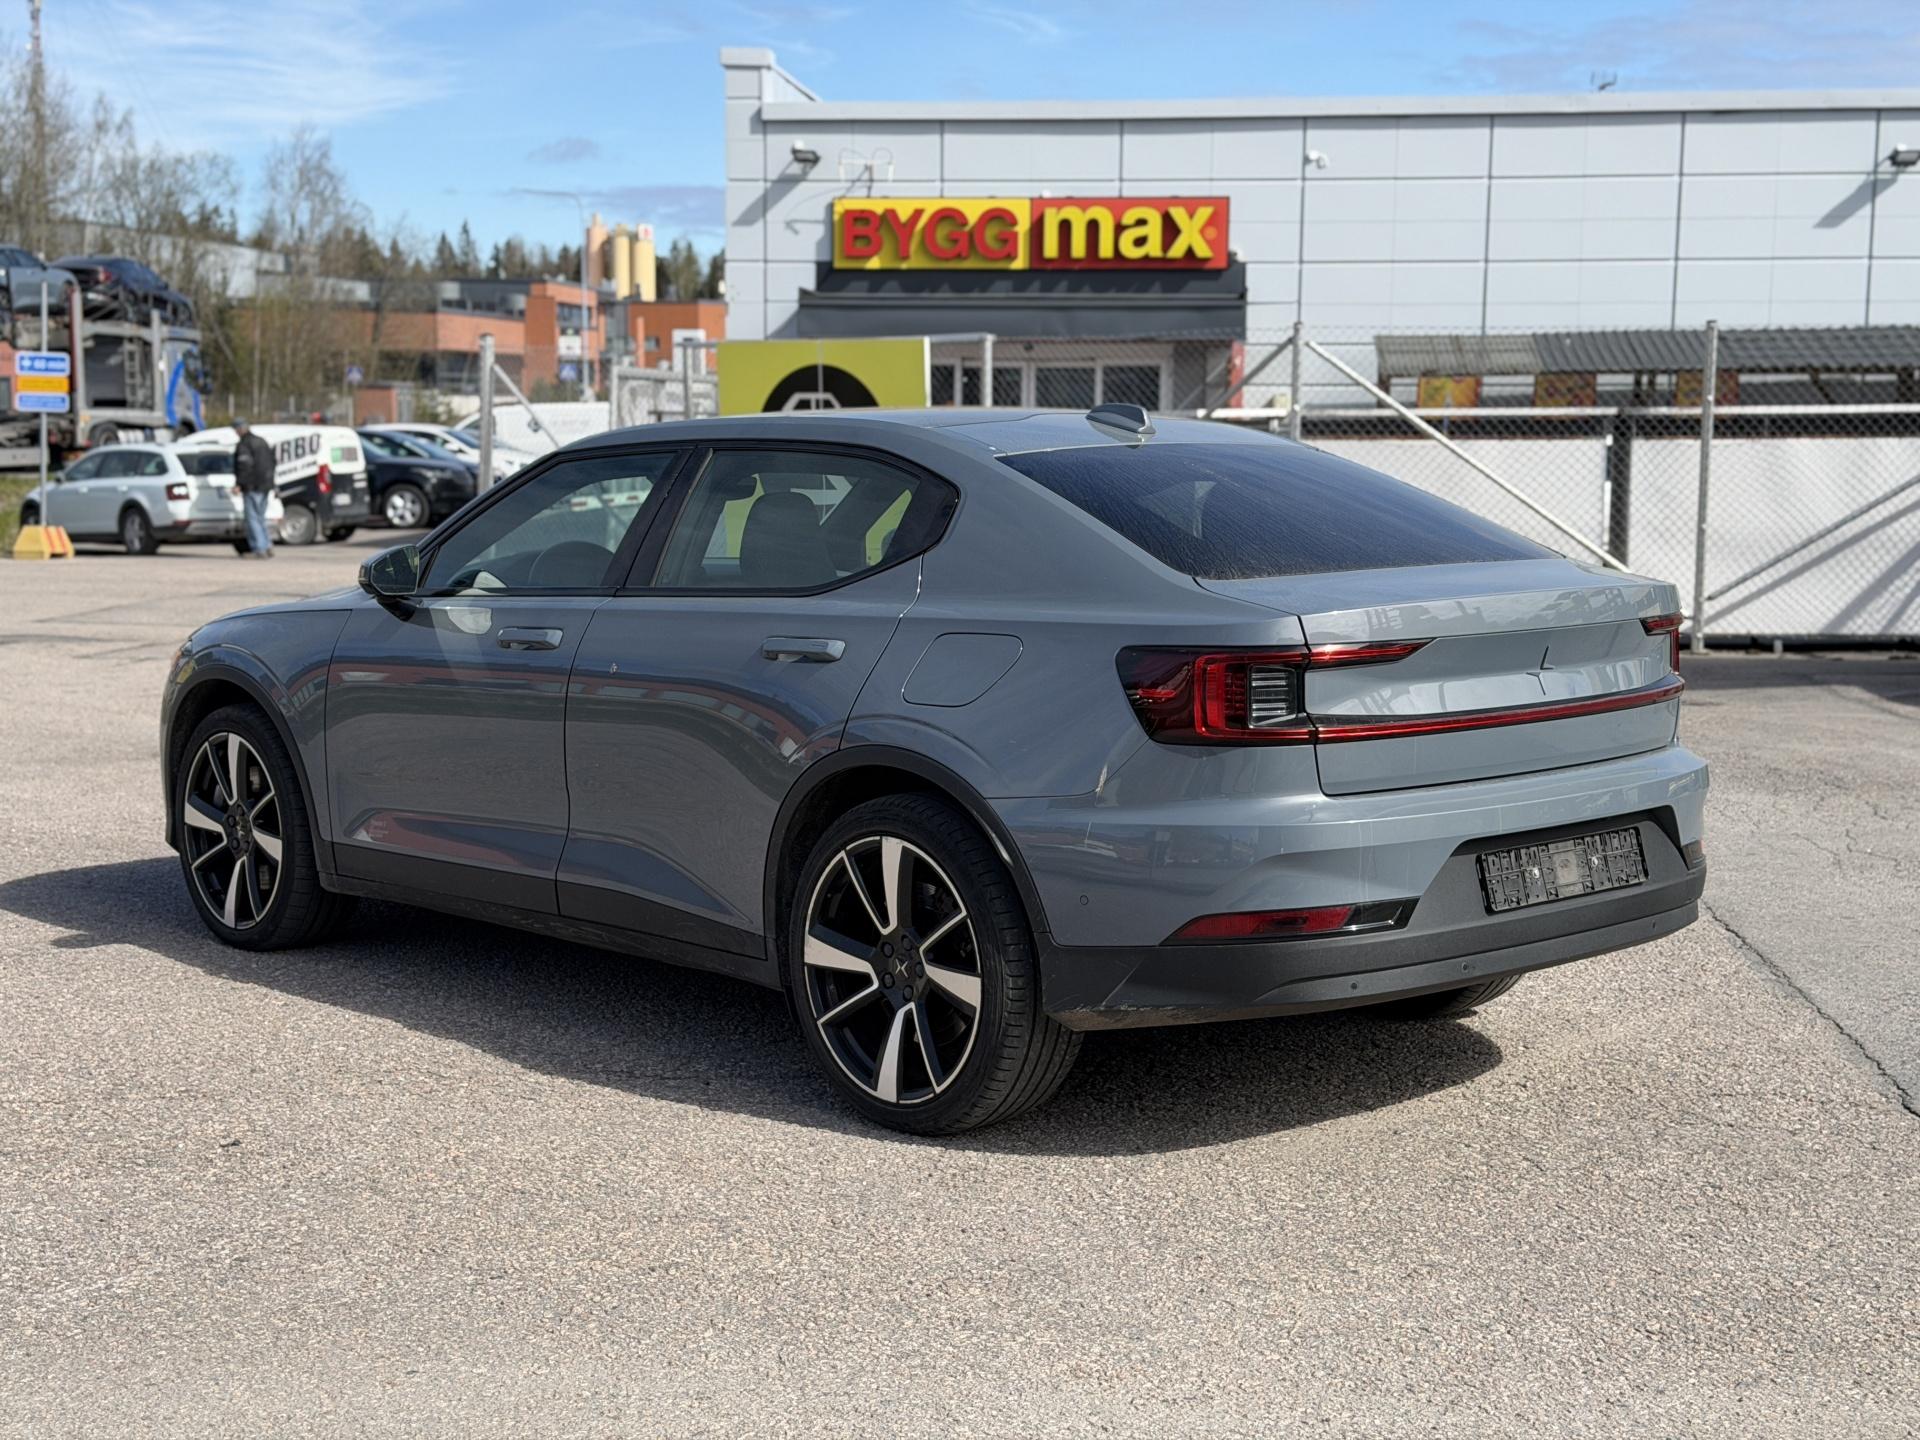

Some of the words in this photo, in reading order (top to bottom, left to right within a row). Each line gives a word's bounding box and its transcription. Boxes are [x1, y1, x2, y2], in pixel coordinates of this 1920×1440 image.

[843, 206, 1019, 261] BYGG
[1042, 205, 1214, 260] max
[275, 433, 321, 465] RBO
